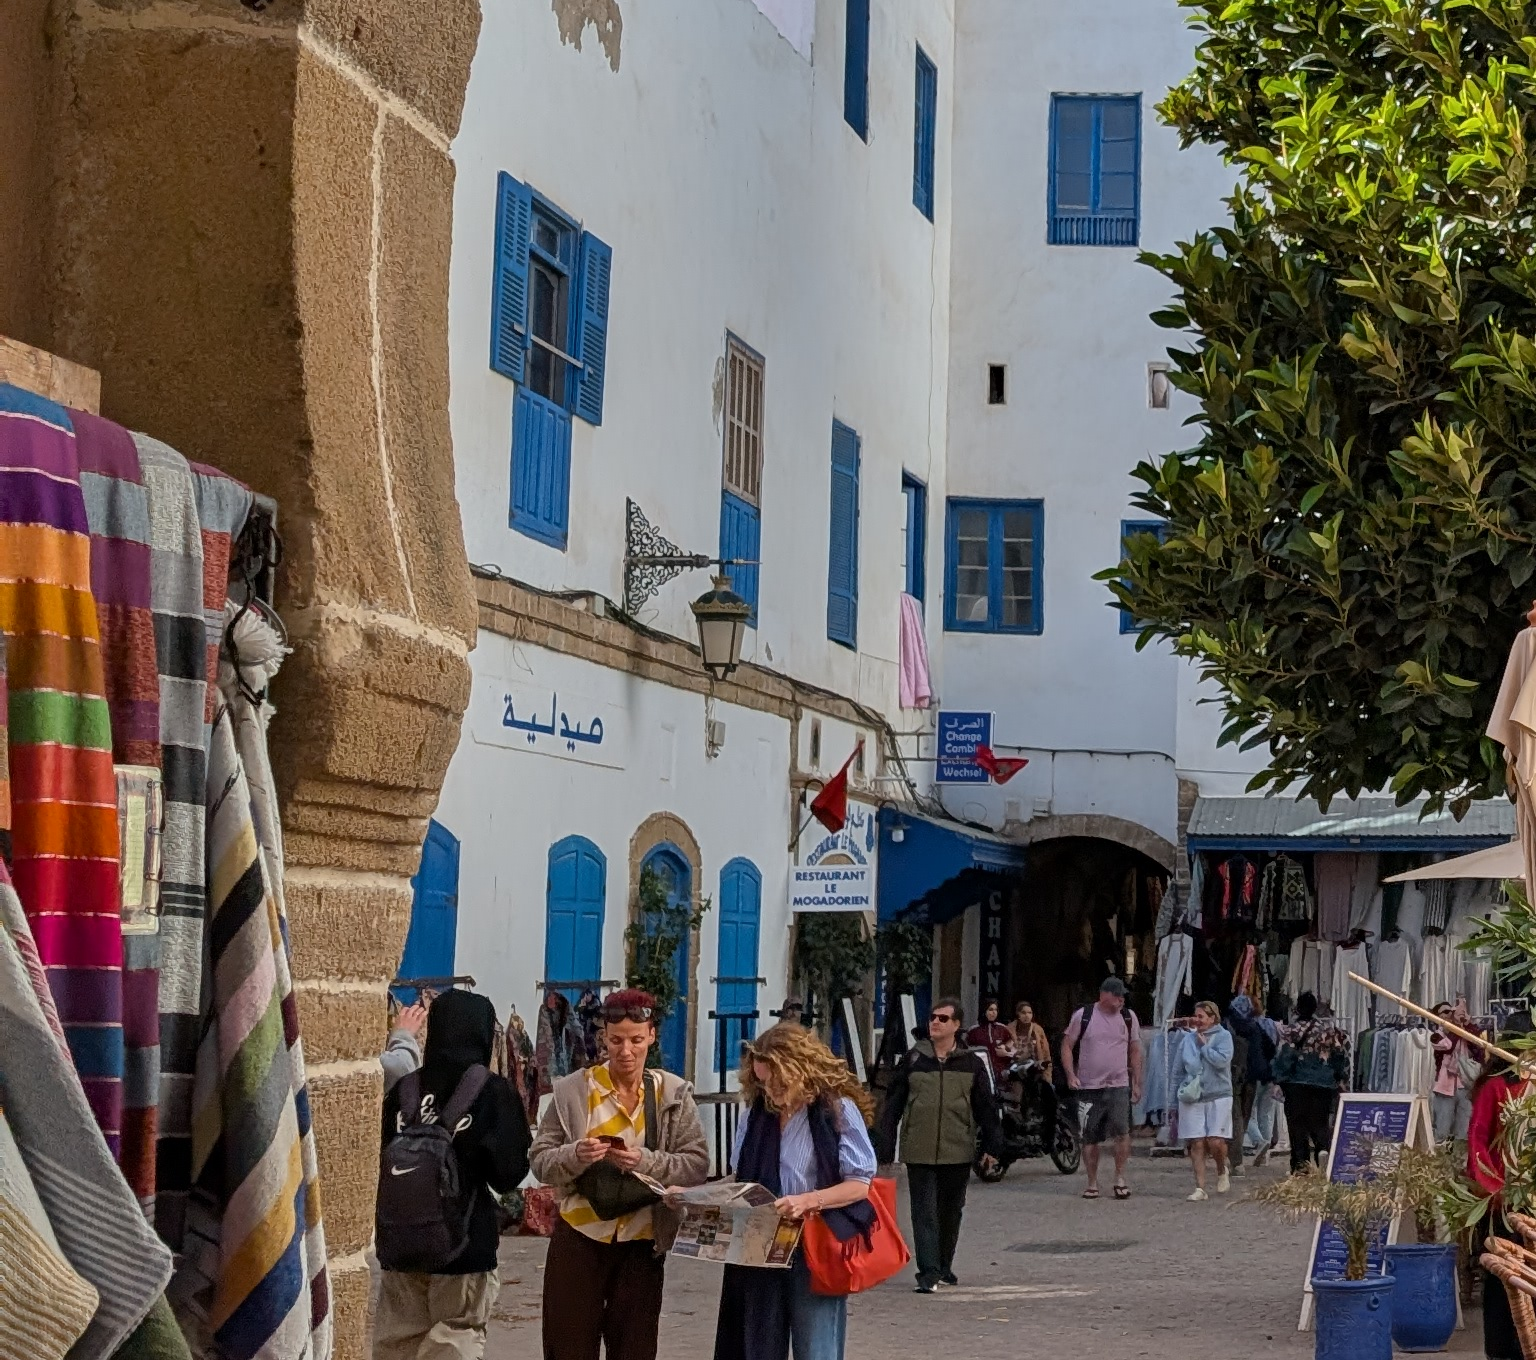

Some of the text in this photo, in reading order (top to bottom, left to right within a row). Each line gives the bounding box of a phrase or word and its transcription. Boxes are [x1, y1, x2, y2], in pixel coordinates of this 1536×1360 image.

[503, 692, 604, 753] صيدلية
[946, 731, 982, 743] Change
[943, 767, 983, 778] Wechsel
[795, 871, 866, 882] RESTAURANT
[825, 884, 837, 893] LE
[793, 896, 869, 907] MOGADORIEN
